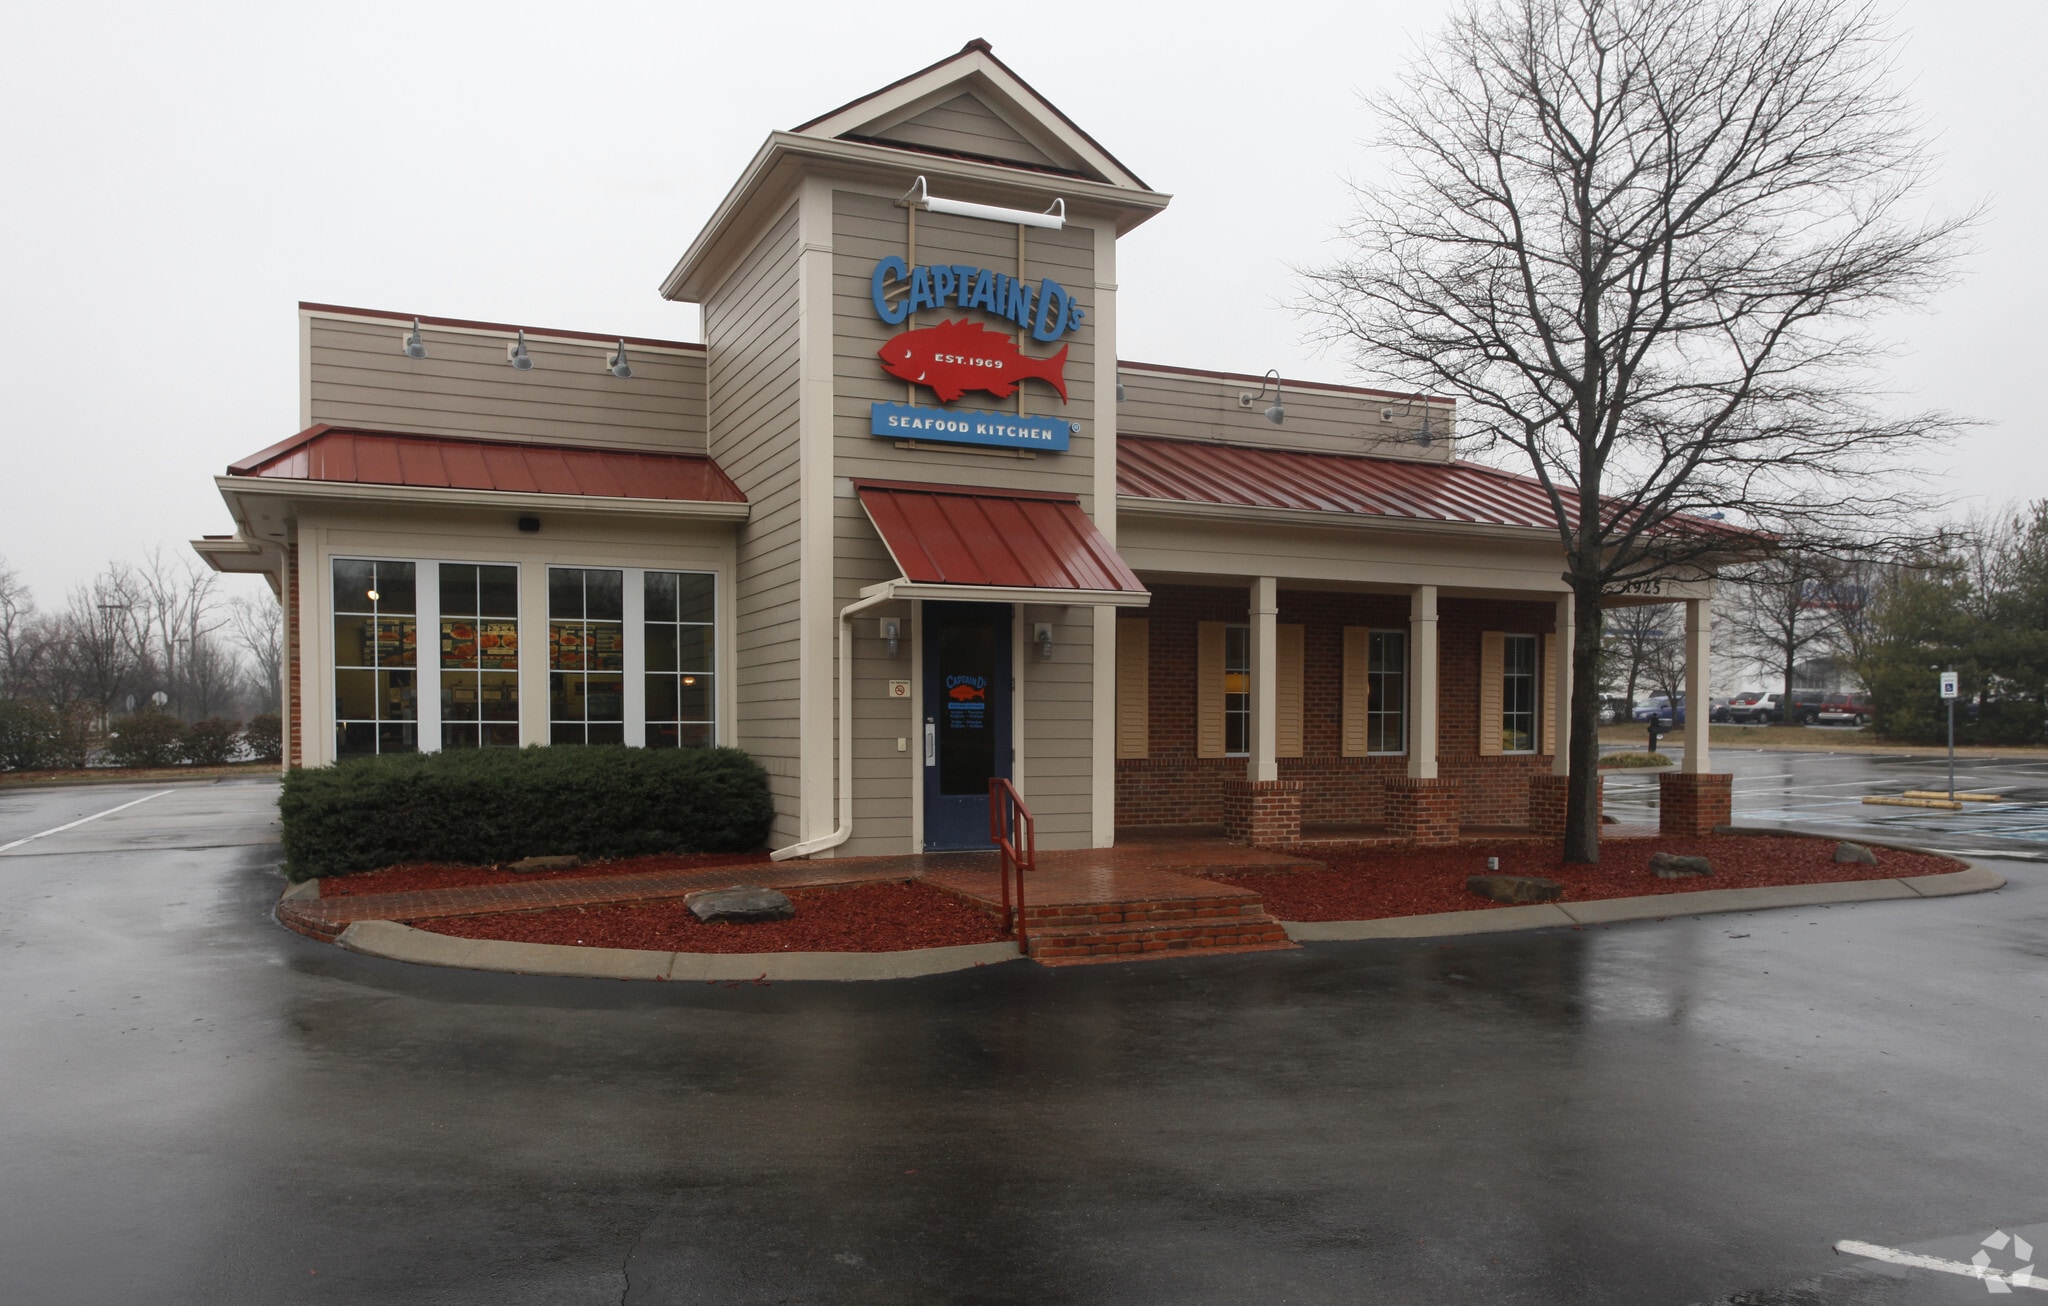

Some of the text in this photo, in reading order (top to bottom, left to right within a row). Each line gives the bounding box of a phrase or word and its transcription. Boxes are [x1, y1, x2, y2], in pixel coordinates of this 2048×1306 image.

[872, 255, 1033, 329] CAPTAIN
[888, 415, 1052, 441] SEAFOOD KITCHEN
[946, 675, 977, 689] CAPTAIN
